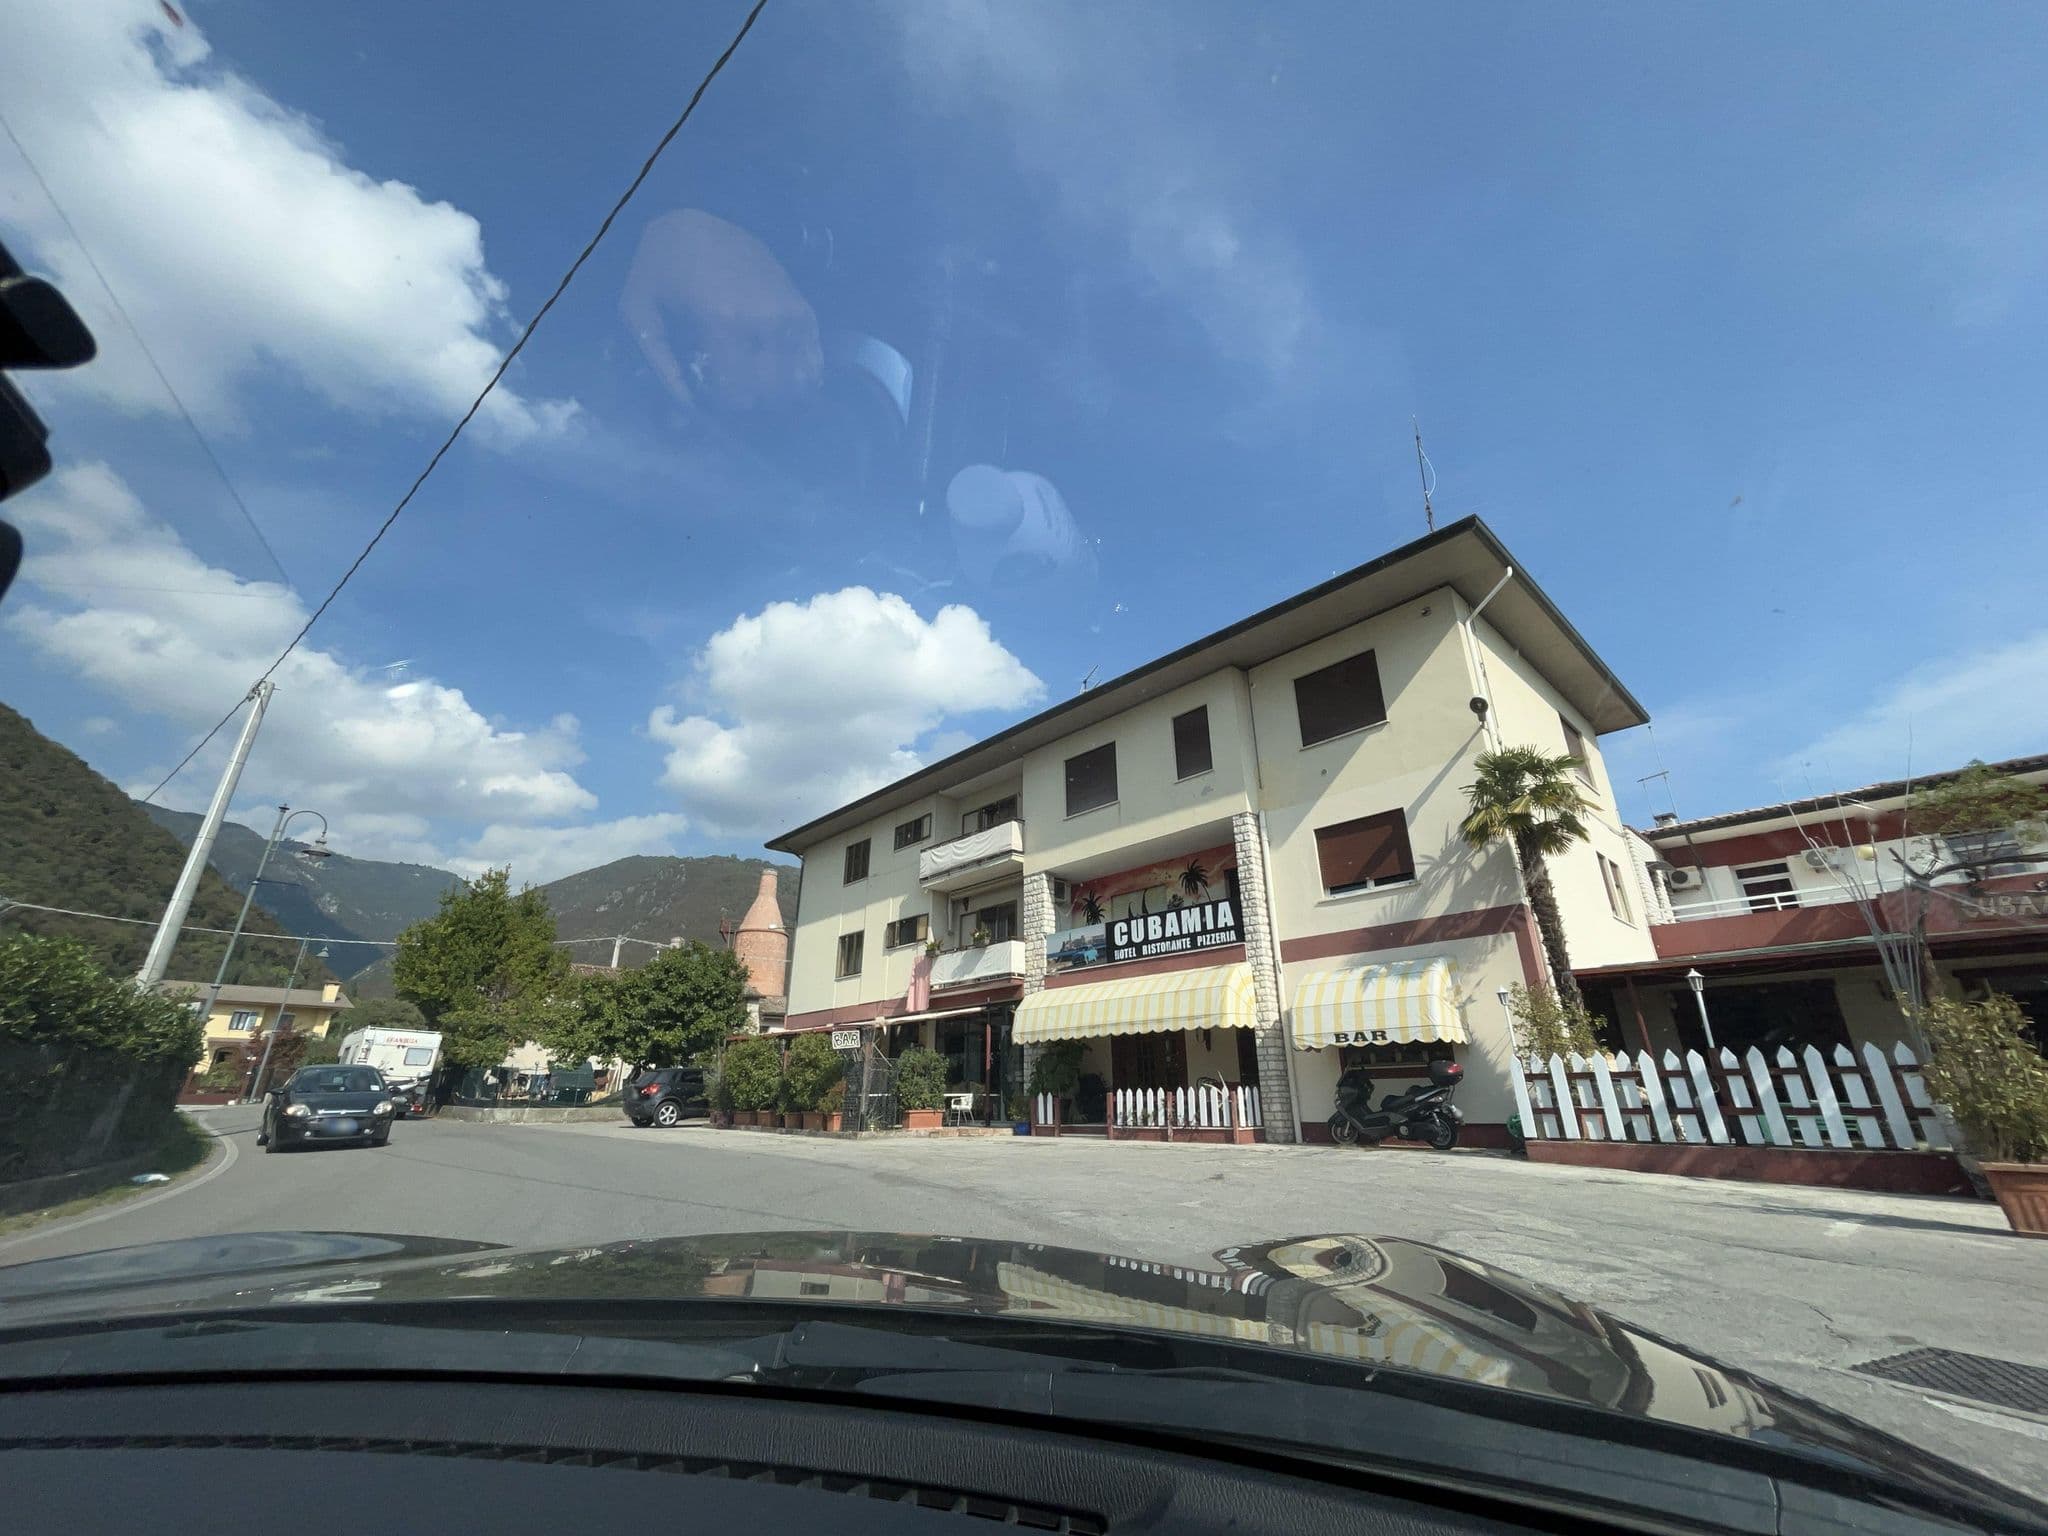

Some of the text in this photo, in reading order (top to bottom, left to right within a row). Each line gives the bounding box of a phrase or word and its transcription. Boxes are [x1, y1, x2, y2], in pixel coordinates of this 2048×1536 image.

[1113, 900, 1235, 947] CUBAMIA
[1114, 929, 1237, 961] HOTEL RISTORANTE PIZZERIA
[834, 1032, 859, 1047] BAR
[1333, 1030, 1388, 1044] BAR
